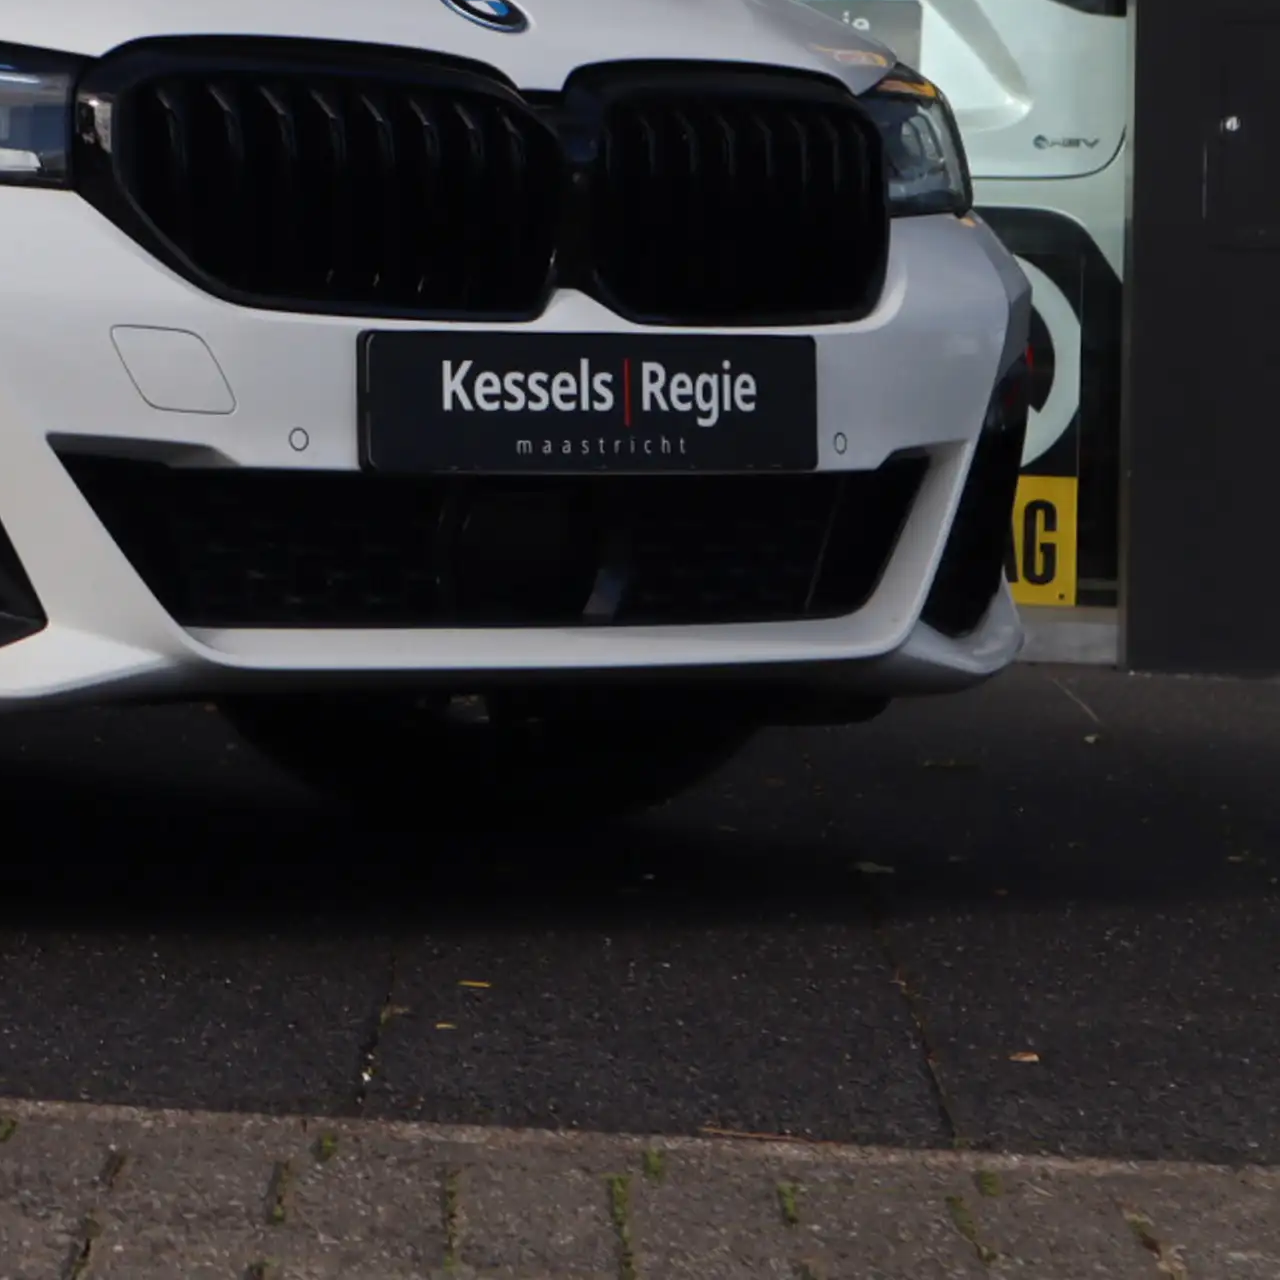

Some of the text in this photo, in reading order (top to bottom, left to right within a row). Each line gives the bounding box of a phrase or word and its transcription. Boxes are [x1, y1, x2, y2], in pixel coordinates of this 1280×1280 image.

[442, 357, 757, 428] Kessels Regie
[516, 436, 687, 455] maastricht
